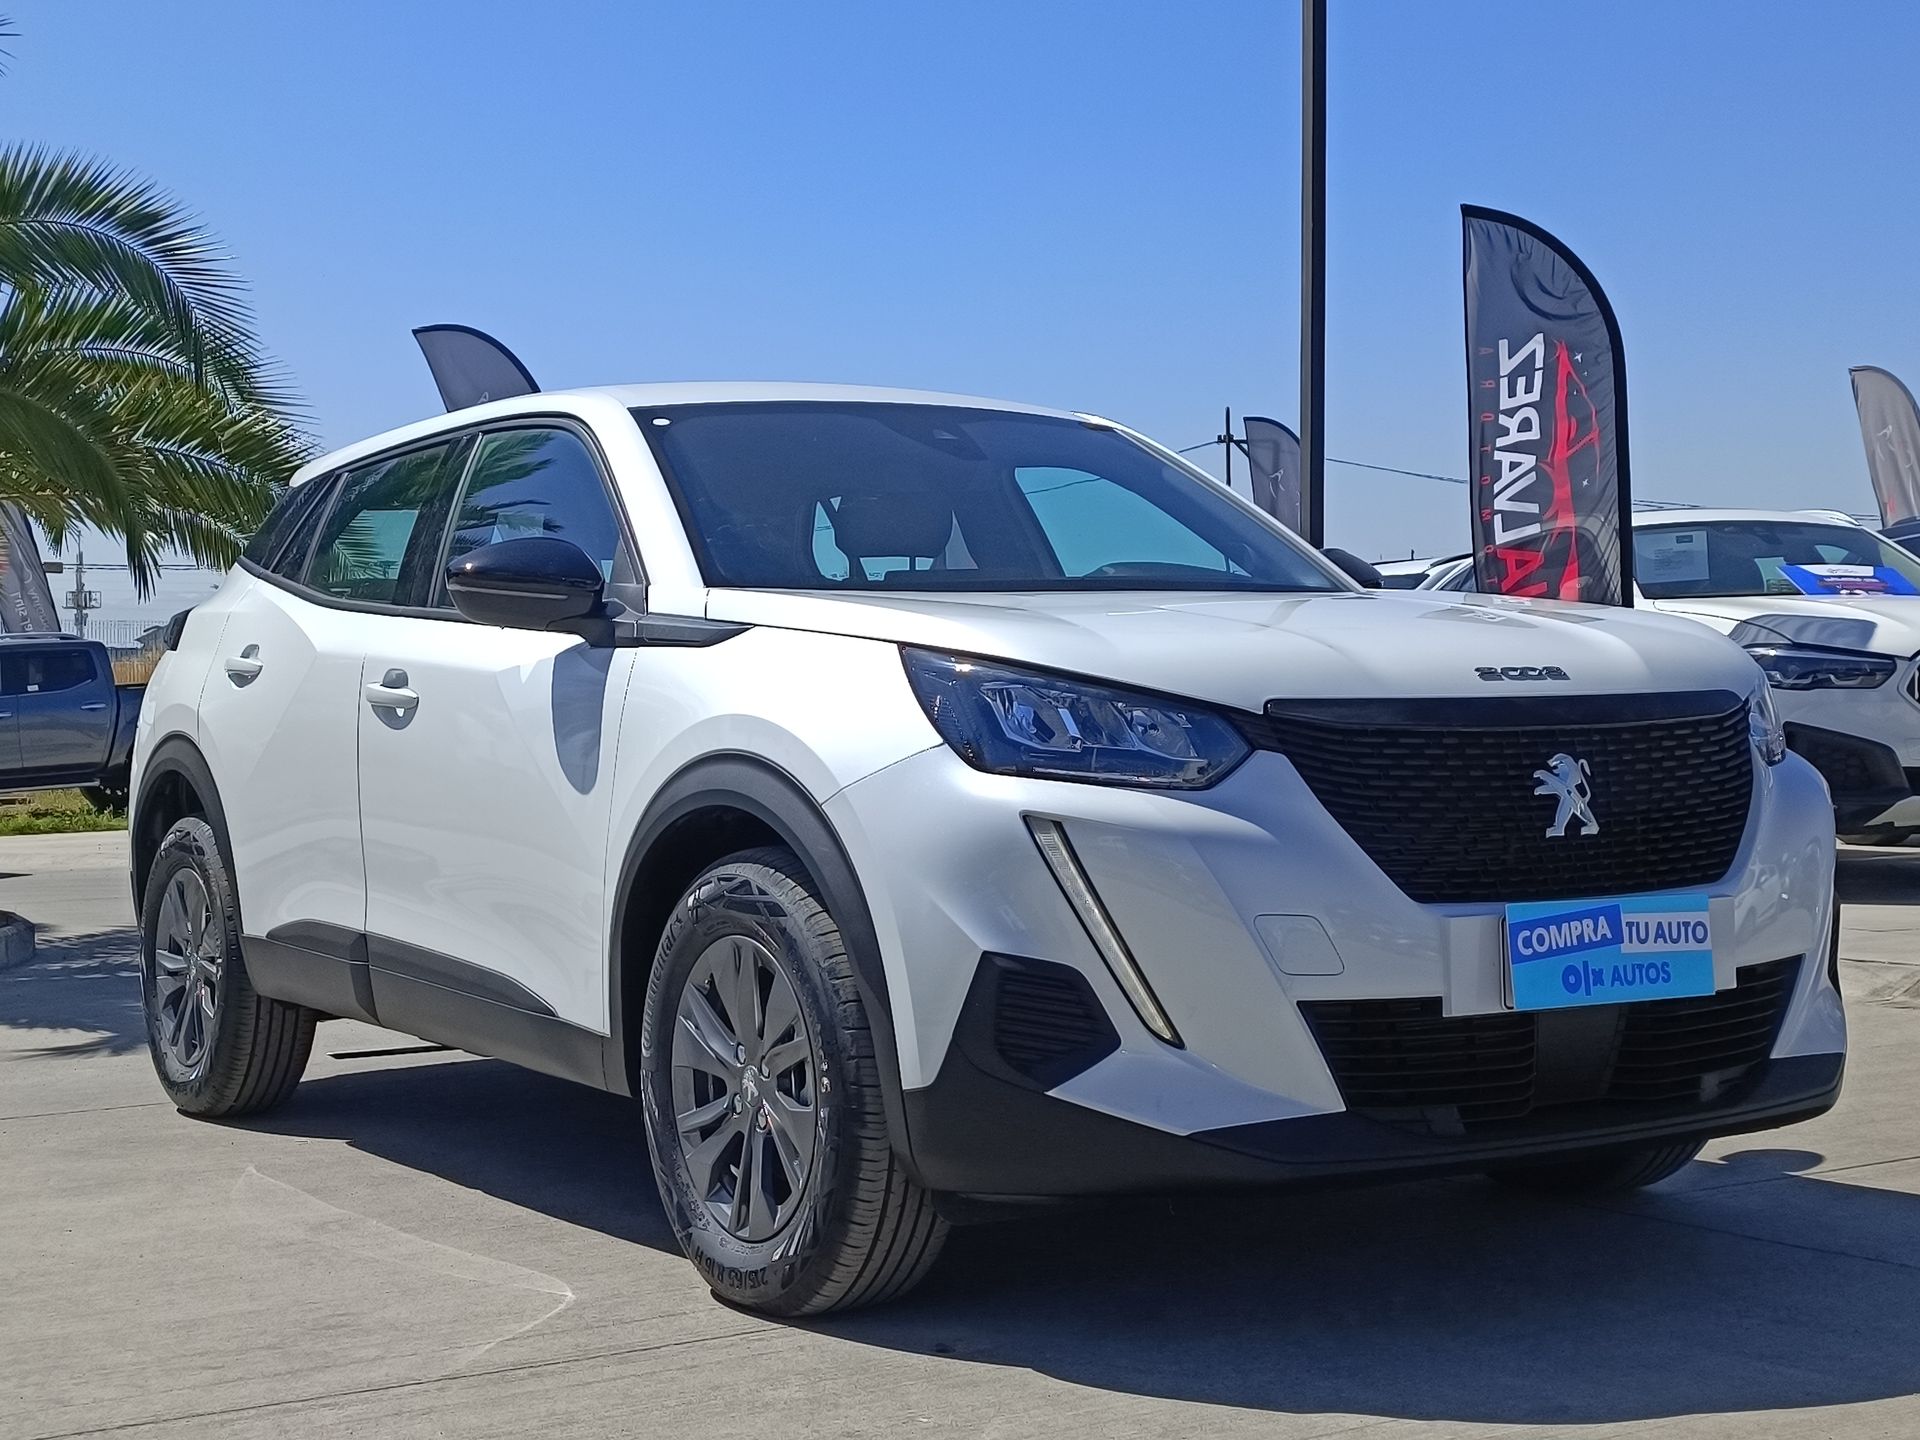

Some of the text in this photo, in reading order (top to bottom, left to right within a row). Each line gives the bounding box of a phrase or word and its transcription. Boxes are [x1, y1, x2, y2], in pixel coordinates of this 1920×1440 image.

[1474, 666, 1571, 681] 2008
[1517, 915, 1709, 956] COMPRA TU AUTO
[1610, 961, 1672, 988] AUTOS
